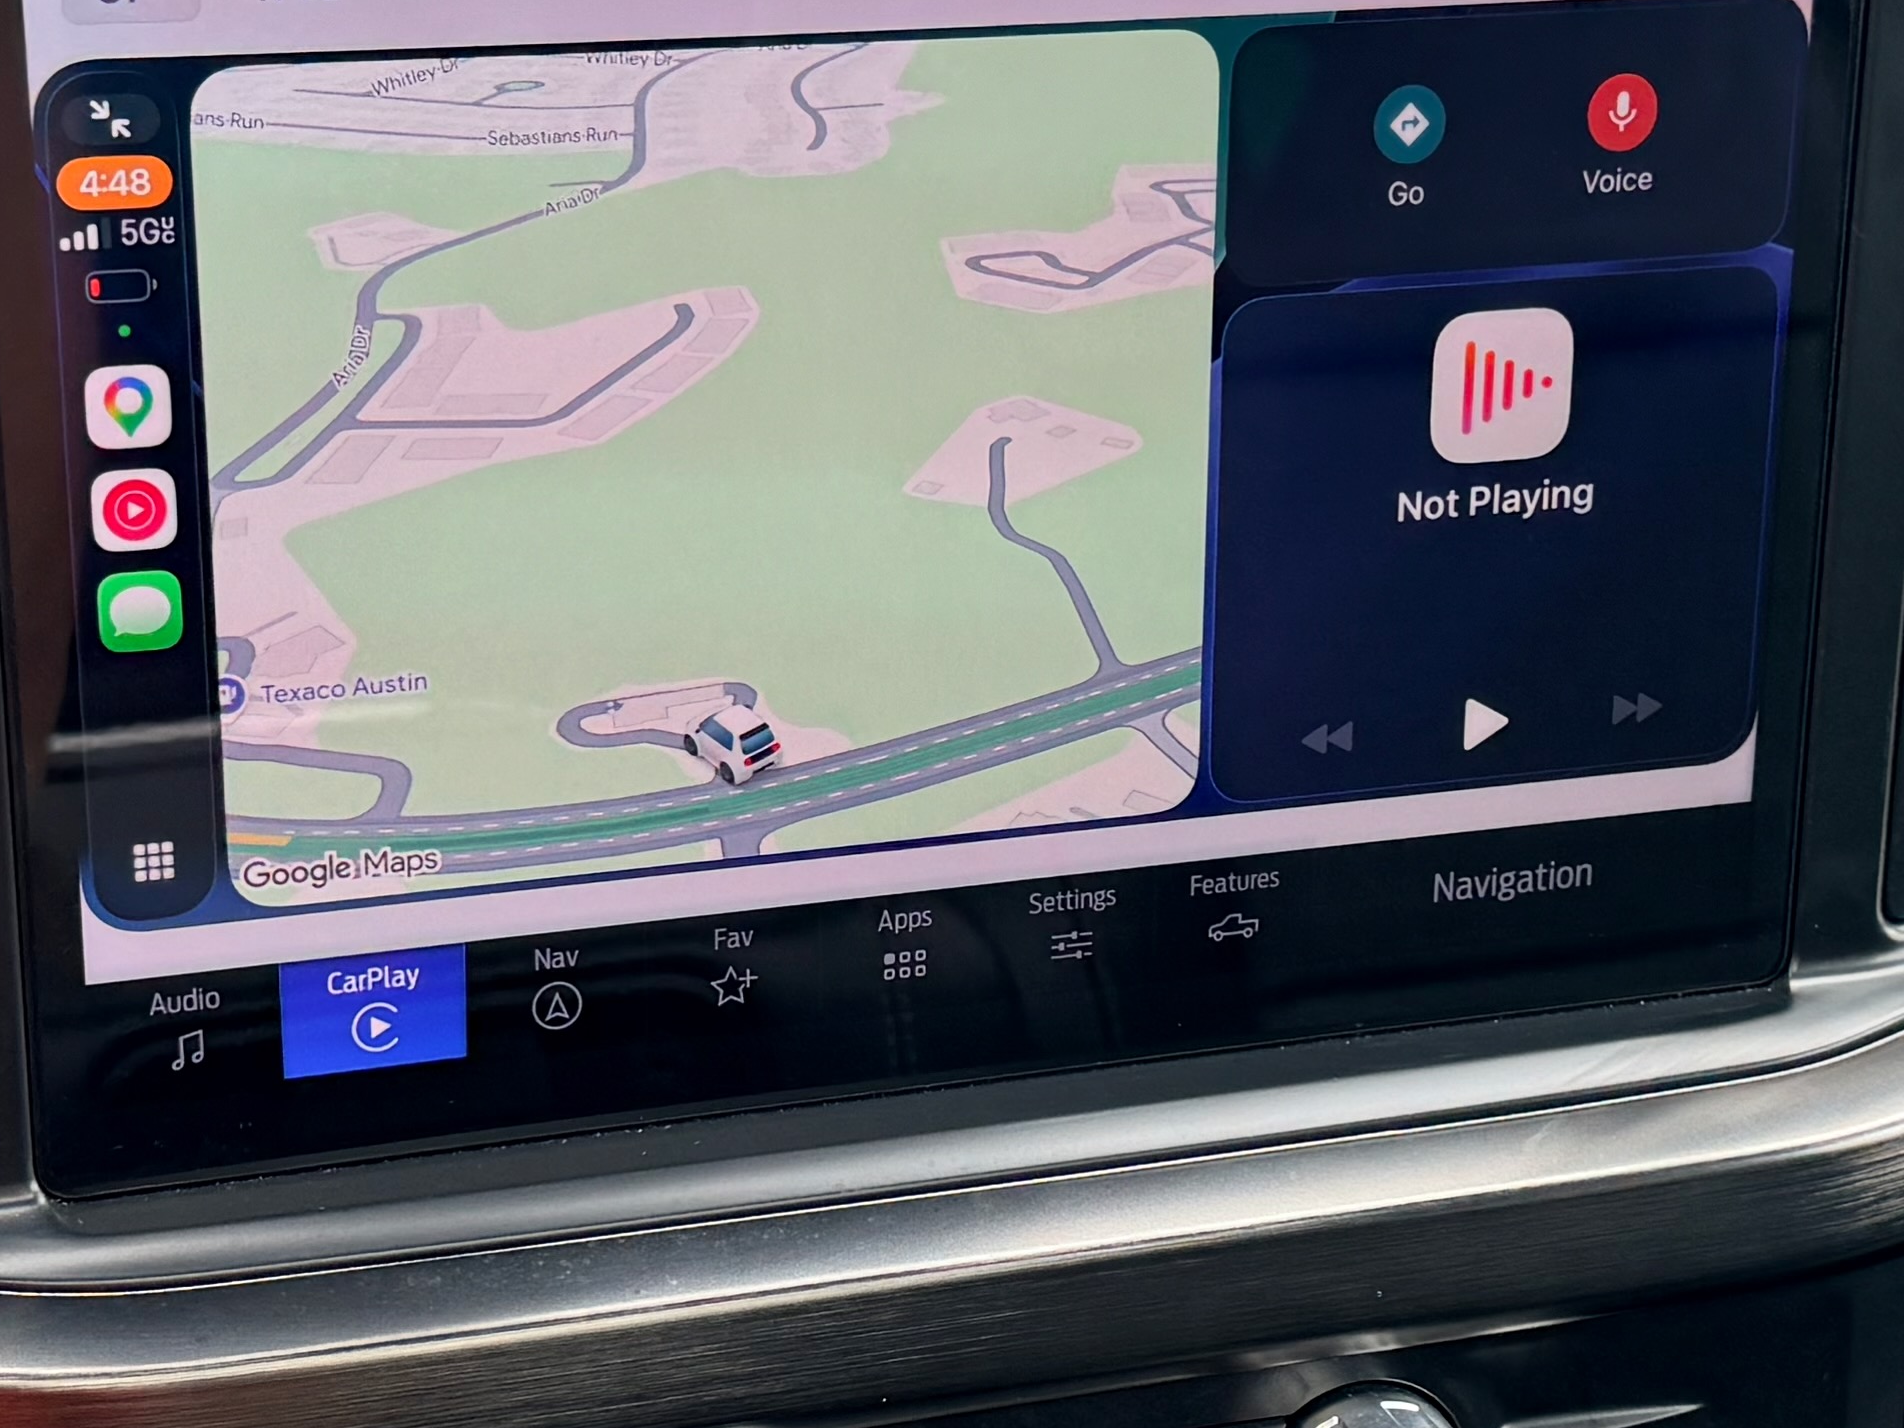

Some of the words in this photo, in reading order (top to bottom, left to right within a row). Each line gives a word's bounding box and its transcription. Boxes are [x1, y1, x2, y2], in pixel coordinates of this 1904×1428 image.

[370, 66, 437, 97] Whitley
[230, 112, 265, 129] Run
[487, 129, 582, 147] Sebastians
[585, 127, 619, 142] Run
[79, 168, 152, 197] 4:48
[1387, 180, 1425, 208] Go
[1582, 167, 1653, 195] Voice
[1396, 489, 1459, 523] Not
[1469, 478, 1595, 517] Playing
[260, 679, 346, 705] Texaco
[352, 672, 429, 698] Austin
[243, 855, 352, 890] Google
[363, 848, 439, 878] Maps
[1432, 860, 1594, 904] Navigation
[1189, 870, 1280, 898] Features
[1028, 886, 1117, 916] Settings
[877, 907, 933, 934] Apps
[713, 927, 755, 951] Fav
[533, 946, 579, 972] Nav
[326, 963, 421, 997] CarPlay
[148, 987, 221, 1017] Audio
